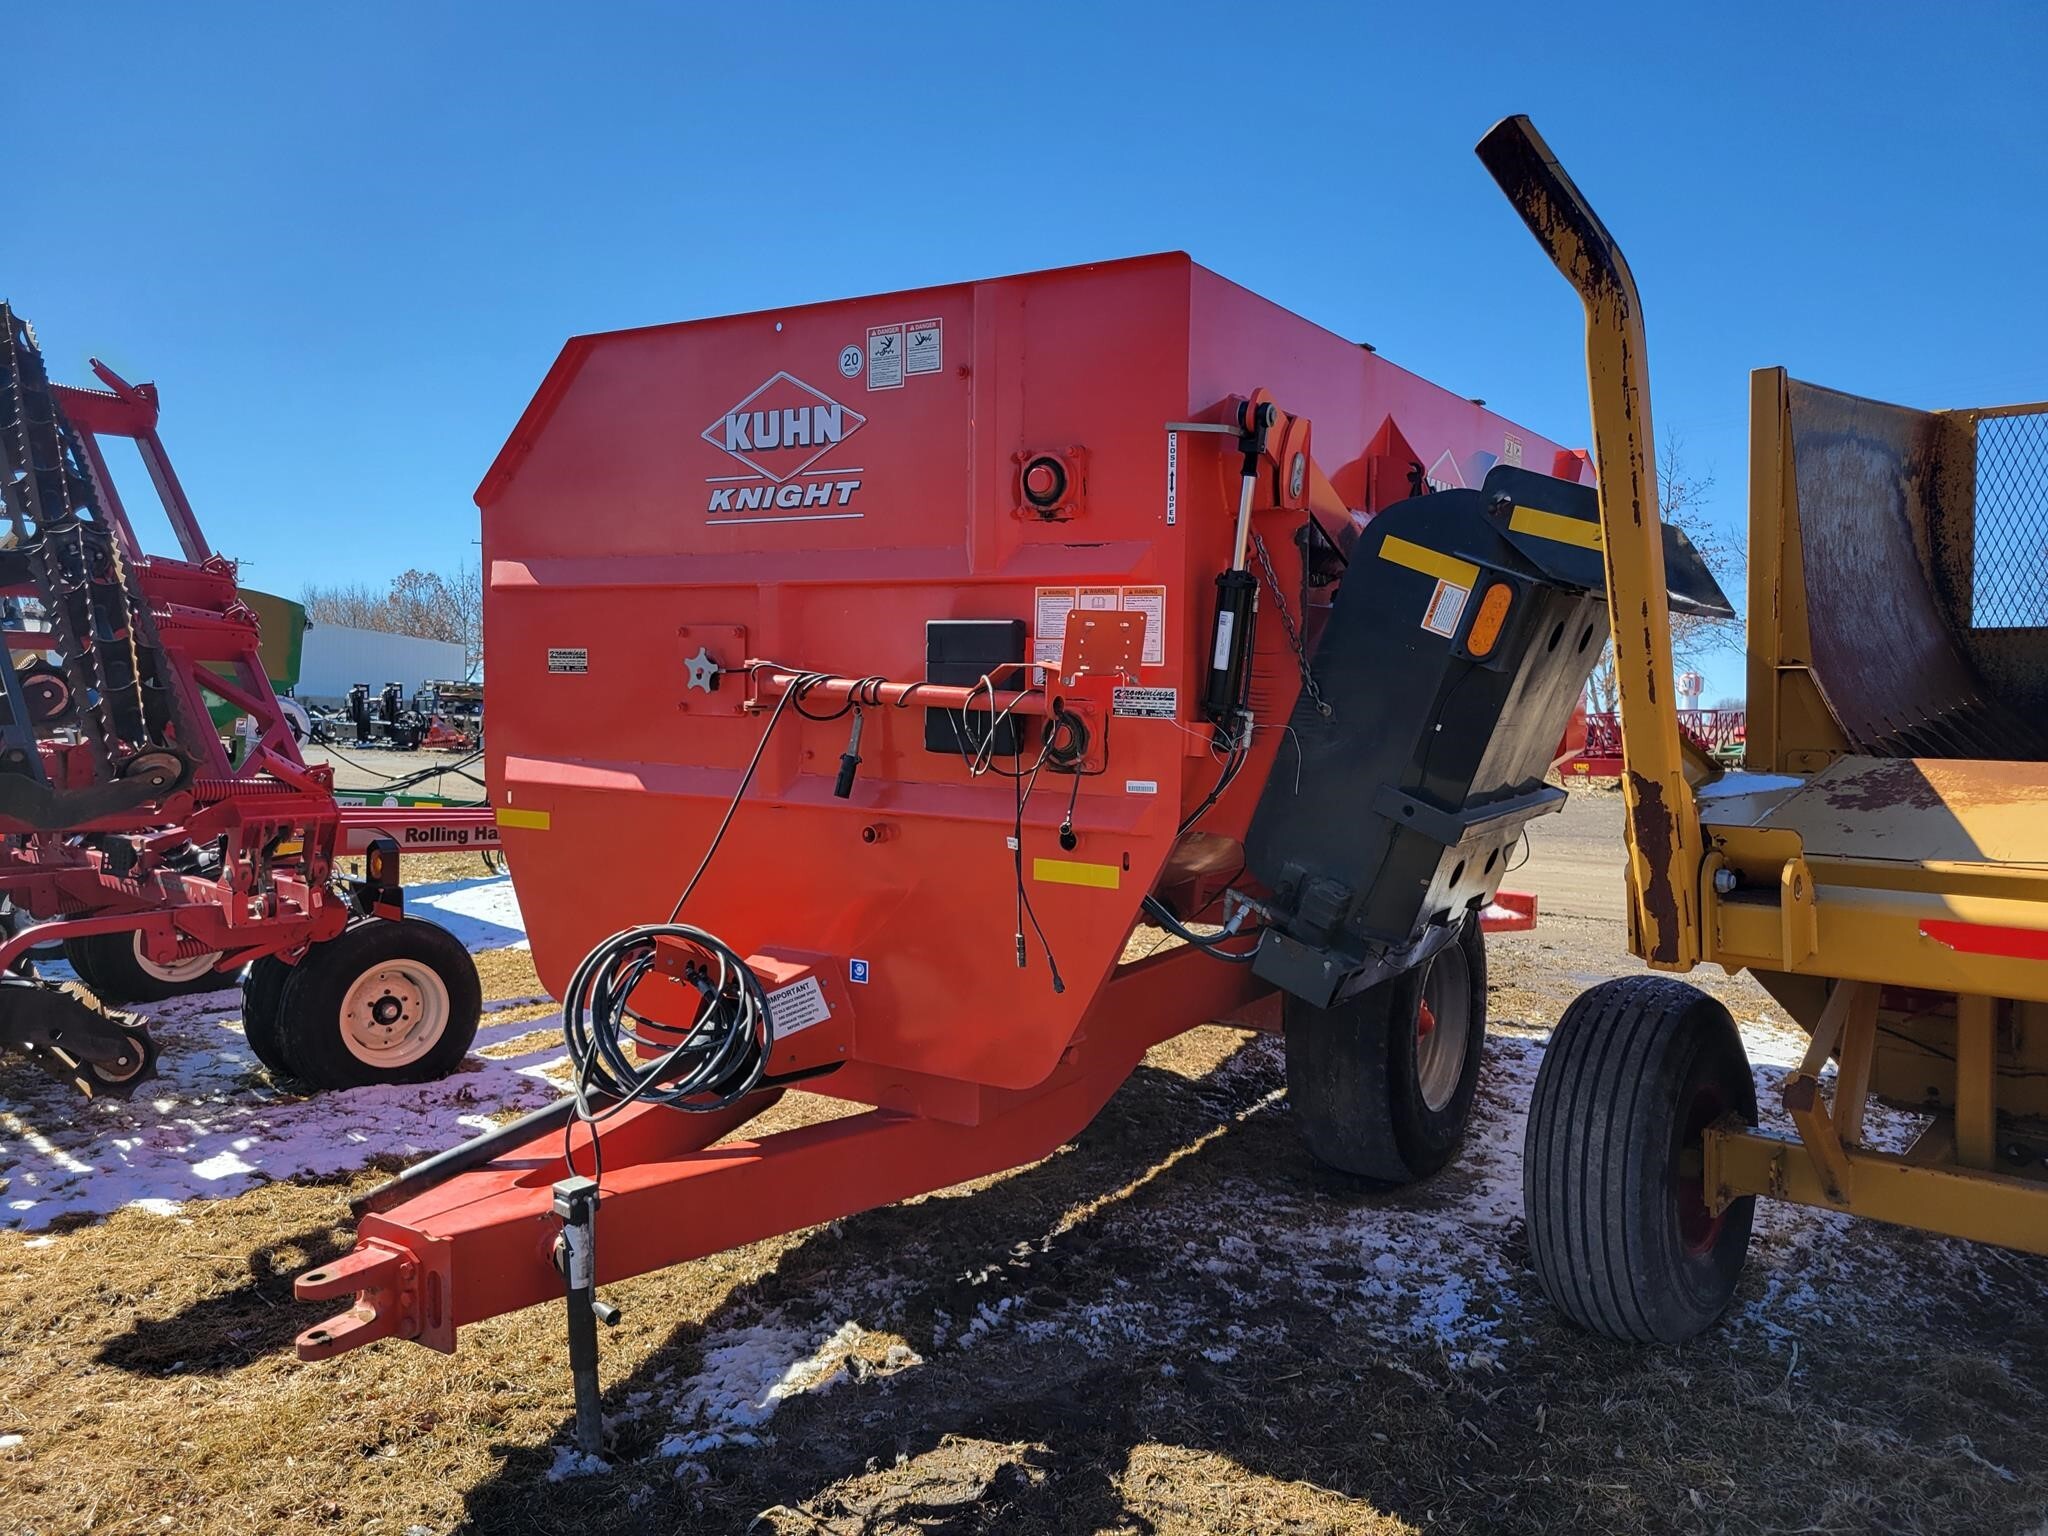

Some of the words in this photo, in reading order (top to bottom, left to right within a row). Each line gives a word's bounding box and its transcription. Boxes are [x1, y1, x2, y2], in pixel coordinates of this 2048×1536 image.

[876, 327, 899, 336] DANGER
[915, 322, 937, 331] DANGER
[844, 353, 859, 367] 20
[724, 404, 843, 452] KUHN
[707, 480, 862, 512] KNIGHT
[405, 827, 468, 844] Rolling
[768, 982, 809, 1004] IMPORTANT
